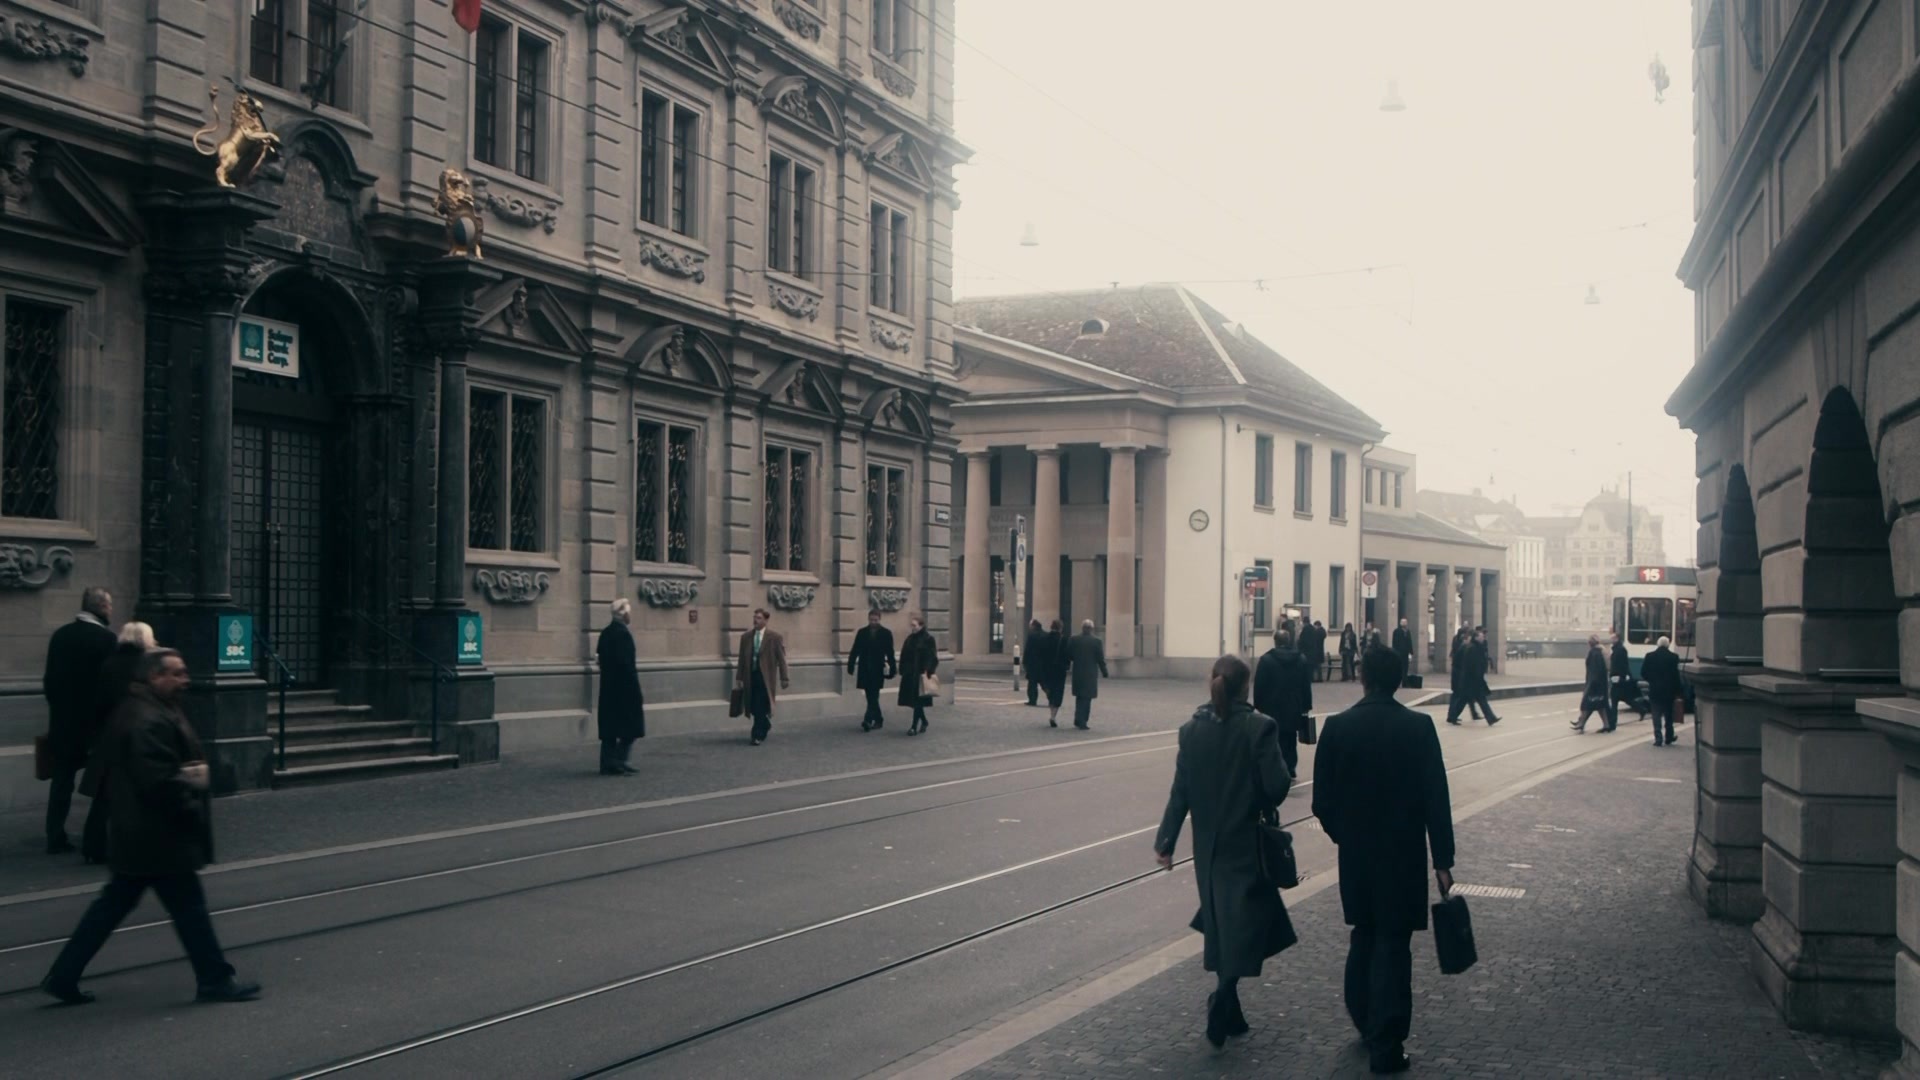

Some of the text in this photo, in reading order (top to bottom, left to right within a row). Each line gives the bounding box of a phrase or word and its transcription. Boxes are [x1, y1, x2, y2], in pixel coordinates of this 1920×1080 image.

[244, 347, 260, 358] SBC
[267, 340, 289, 355] Bank
[1643, 568, 1660, 581] 15
[226, 645, 245, 656] SBC
[463, 642, 478, 651] SBC
